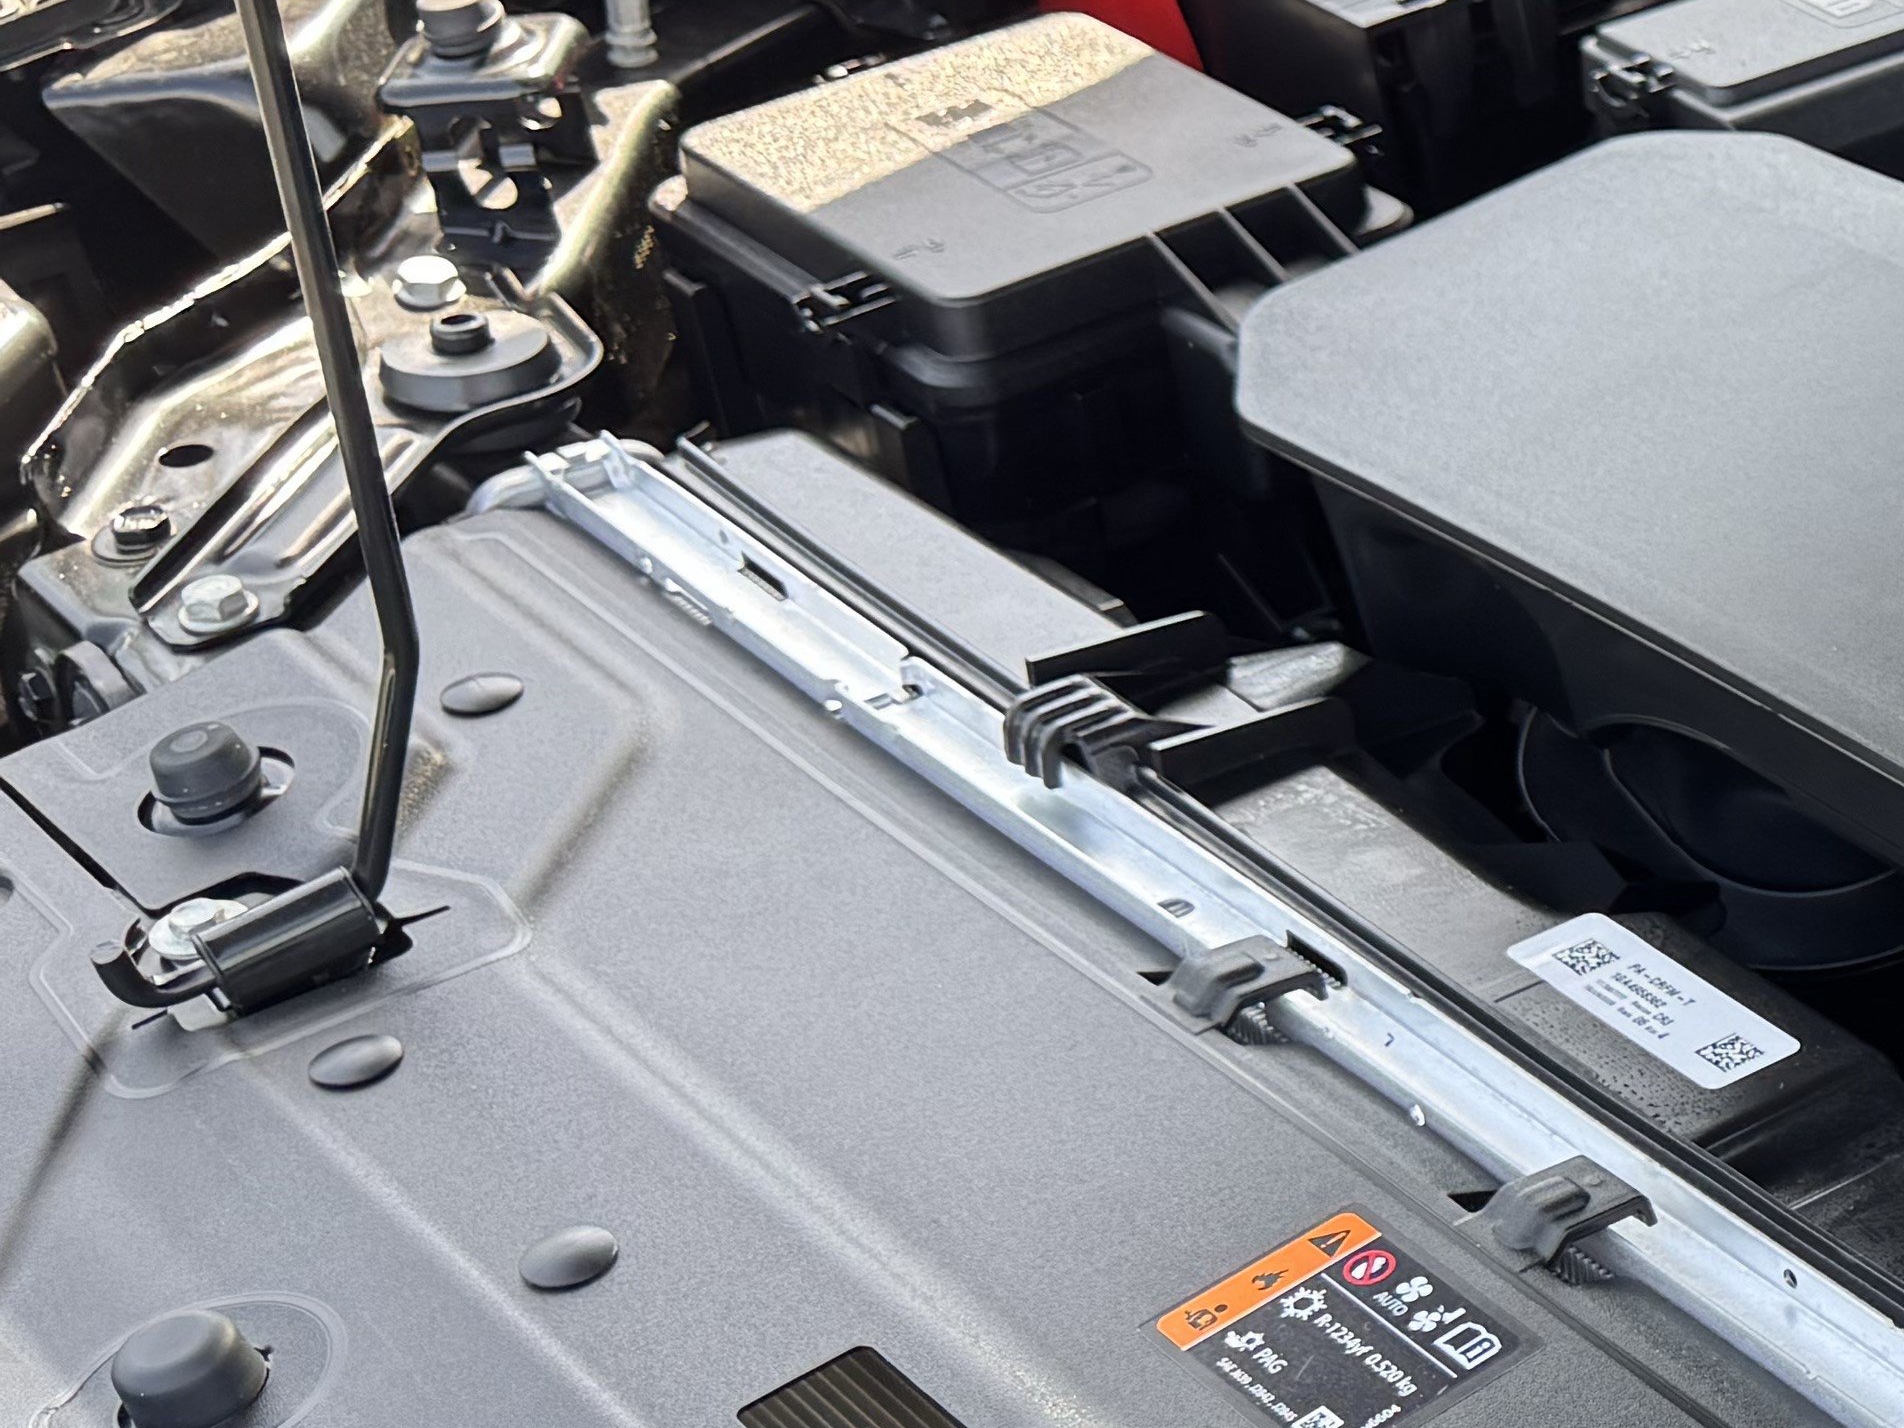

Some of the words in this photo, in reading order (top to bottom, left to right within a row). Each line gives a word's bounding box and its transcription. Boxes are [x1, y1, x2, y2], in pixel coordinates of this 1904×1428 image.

[1373, 1291, 1408, 1316] AUTO
[1252, 1347, 1289, 1375] PAG
[1313, 1313, 1373, 1359] R-1234yf
[1398, 1376, 1418, 1398] kg
